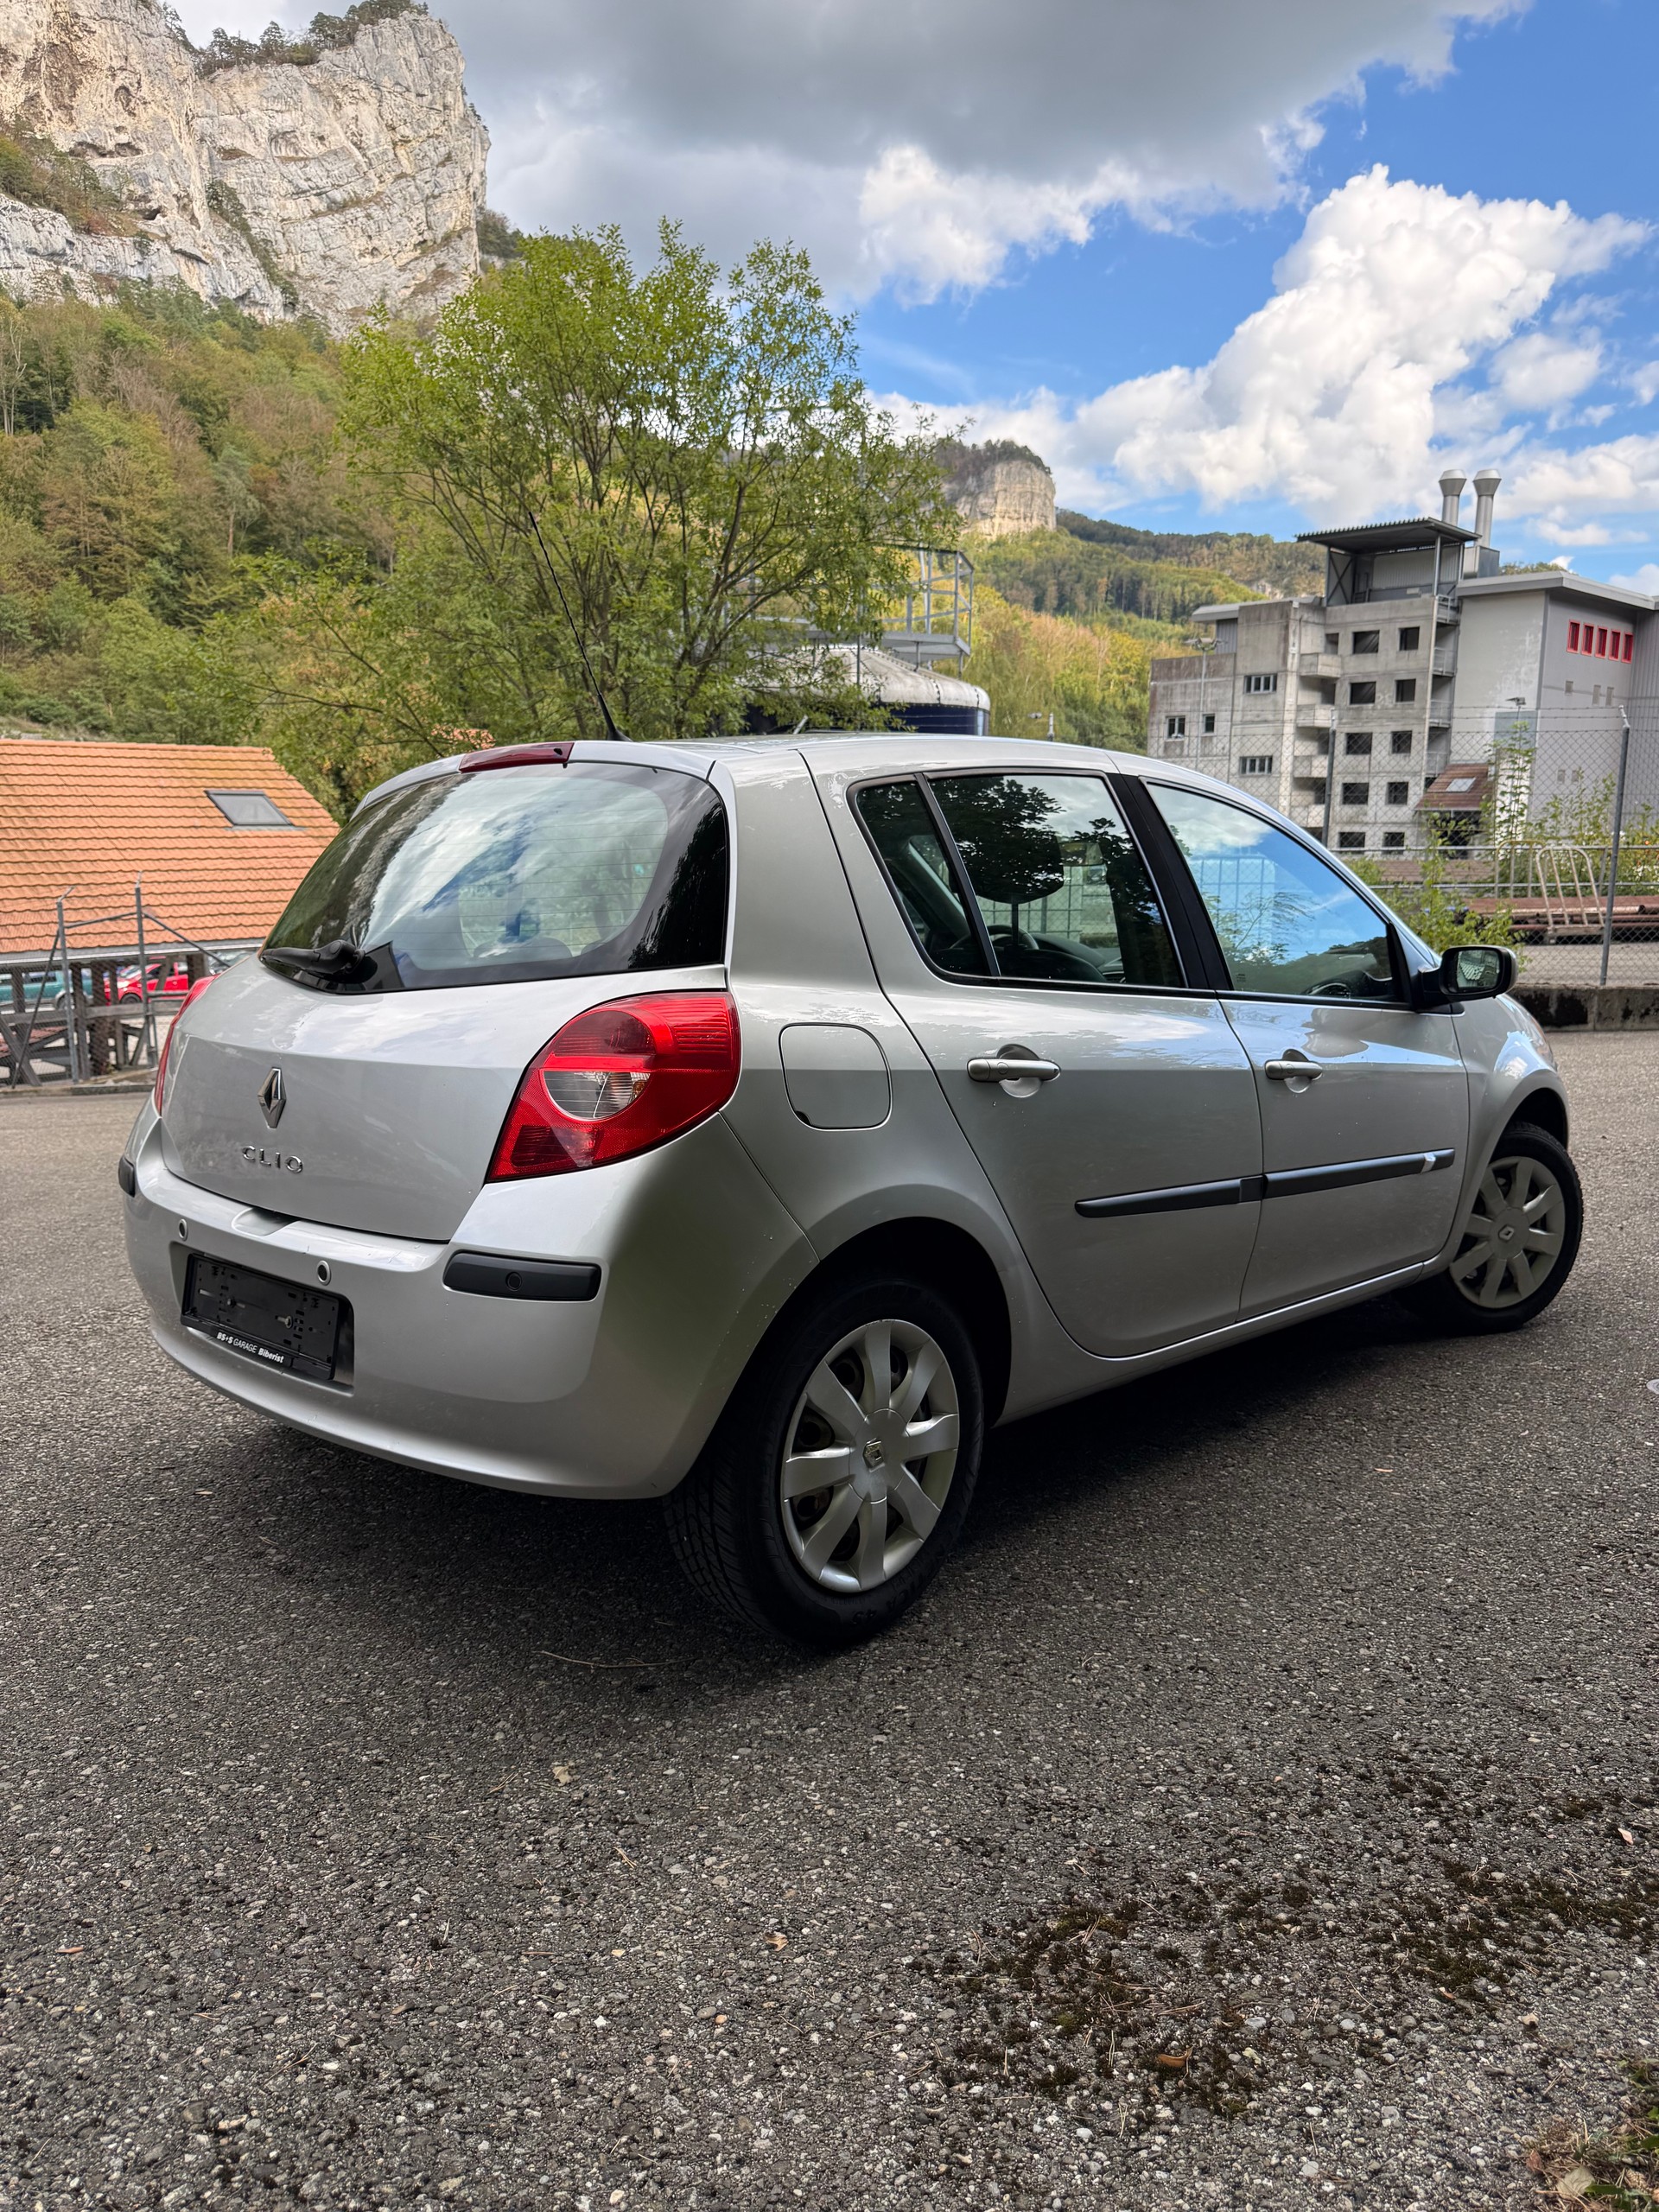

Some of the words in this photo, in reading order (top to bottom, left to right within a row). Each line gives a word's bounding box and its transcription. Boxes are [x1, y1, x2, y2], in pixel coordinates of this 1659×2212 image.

[242, 1145, 303, 1173] CLIO
[217, 1332, 233, 1344] BS+S
[233, 1338, 257, 1353] GARAGE
[258, 1348, 284, 1363] Biberist
